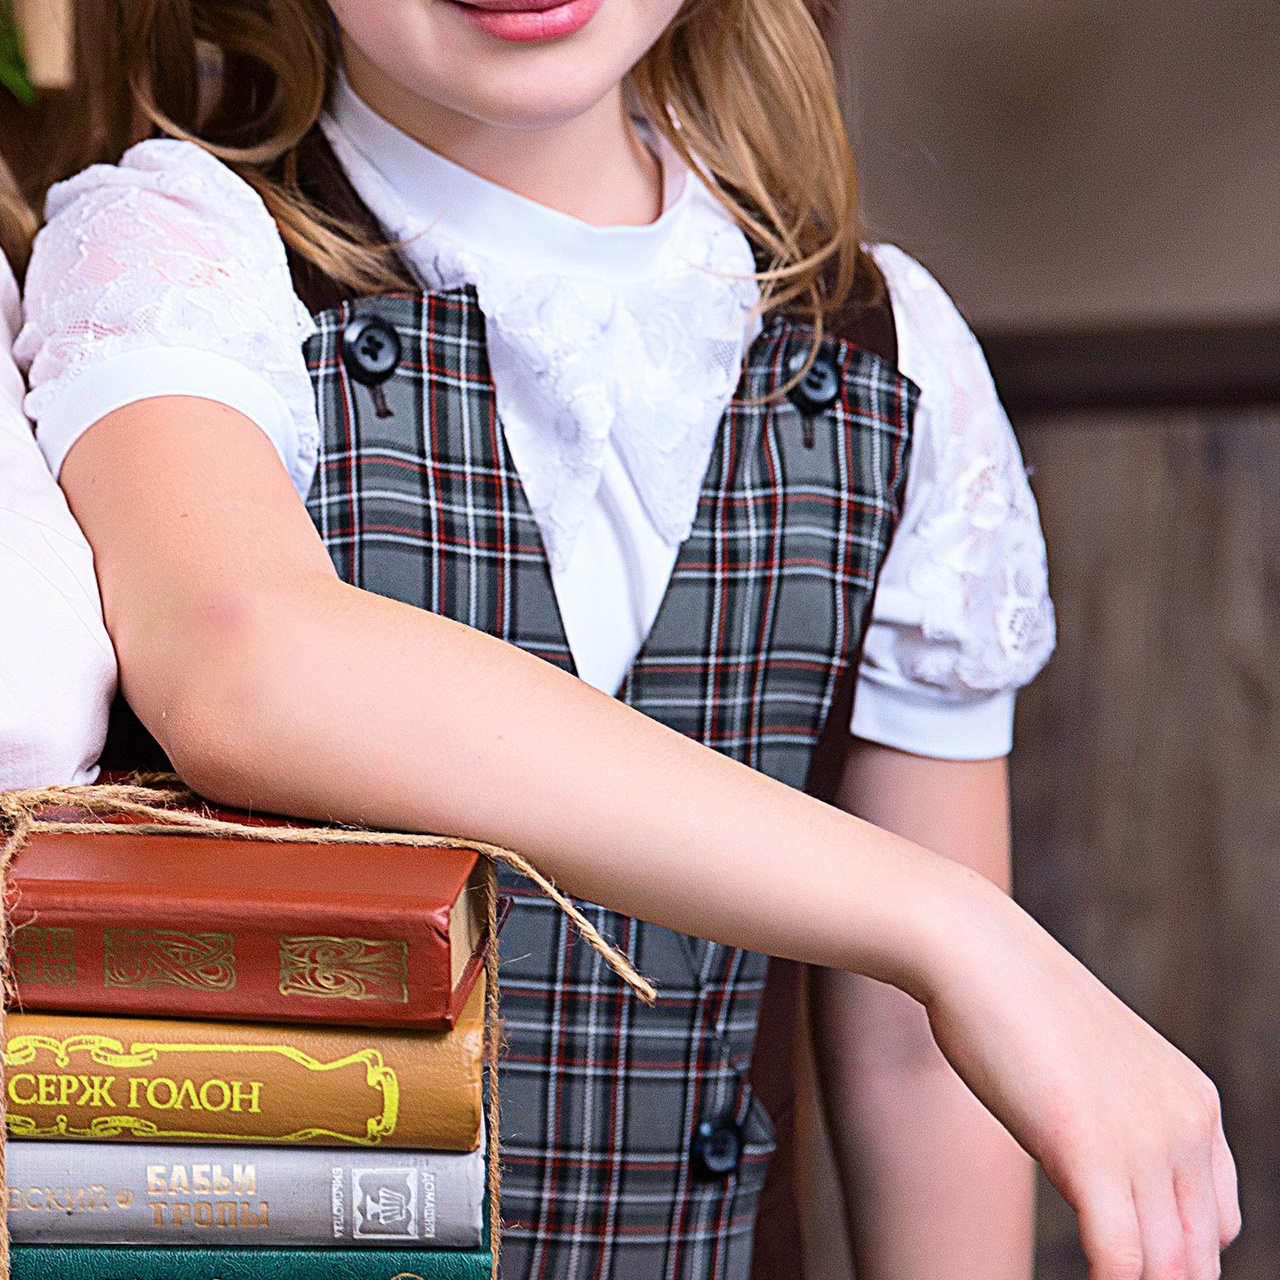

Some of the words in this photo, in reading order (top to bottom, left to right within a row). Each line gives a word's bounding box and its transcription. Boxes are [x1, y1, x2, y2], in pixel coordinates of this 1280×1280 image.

[8, 1073, 117, 1108] СЕРЖ
[127, 1076, 264, 1114] ГОЛОН
[146, 1163, 258, 1196] БАБЬИ
[147, 1200, 270, 1229] ТРОПЫ
